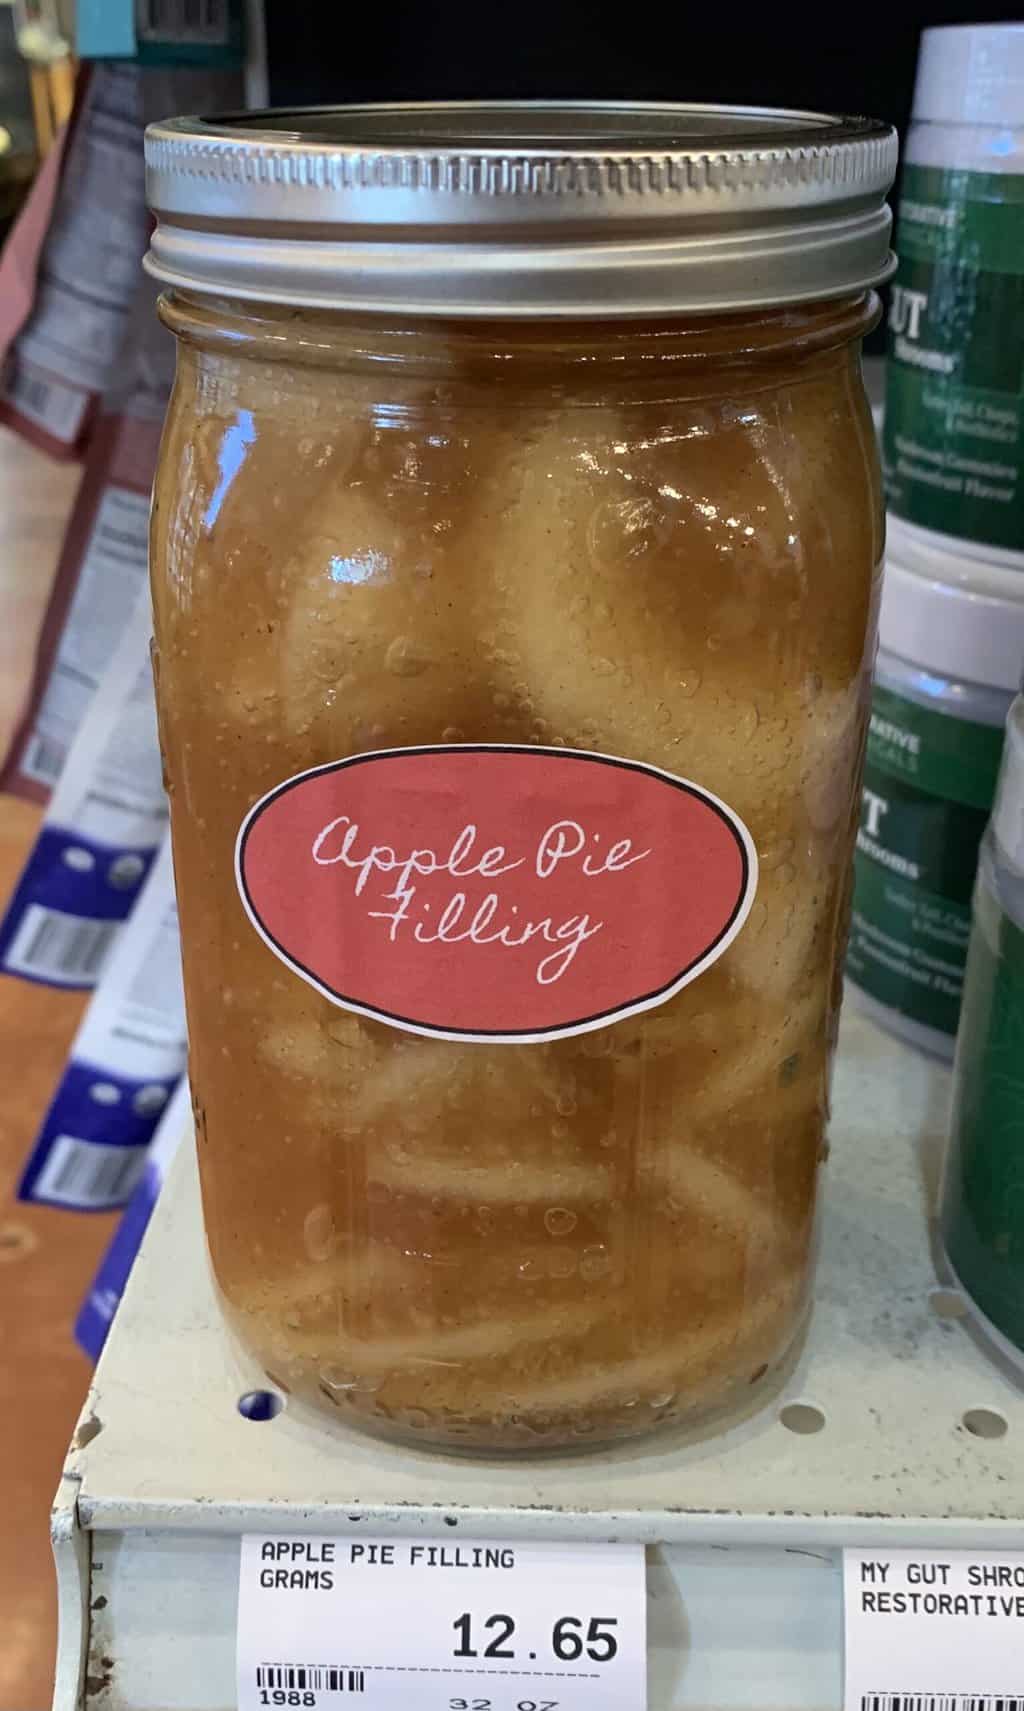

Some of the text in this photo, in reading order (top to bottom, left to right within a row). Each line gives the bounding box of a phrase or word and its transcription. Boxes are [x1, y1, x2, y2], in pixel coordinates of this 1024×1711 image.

[311, 815, 652, 898] Apple Pie
[368, 888, 603, 985] Filling
[261, 1541, 515, 1569] APPLE PIE FILLING
[260, 1569, 334, 1590] GRAMS
[861, 1561, 1024, 1588] MY GUT SHRO
[862, 1591, 1024, 1617] RESTORATIVE
[453, 1612, 619, 1663] 12.65
[260, 1689, 317, 1707] 1988
[449, 1698, 492, 1711] 32
